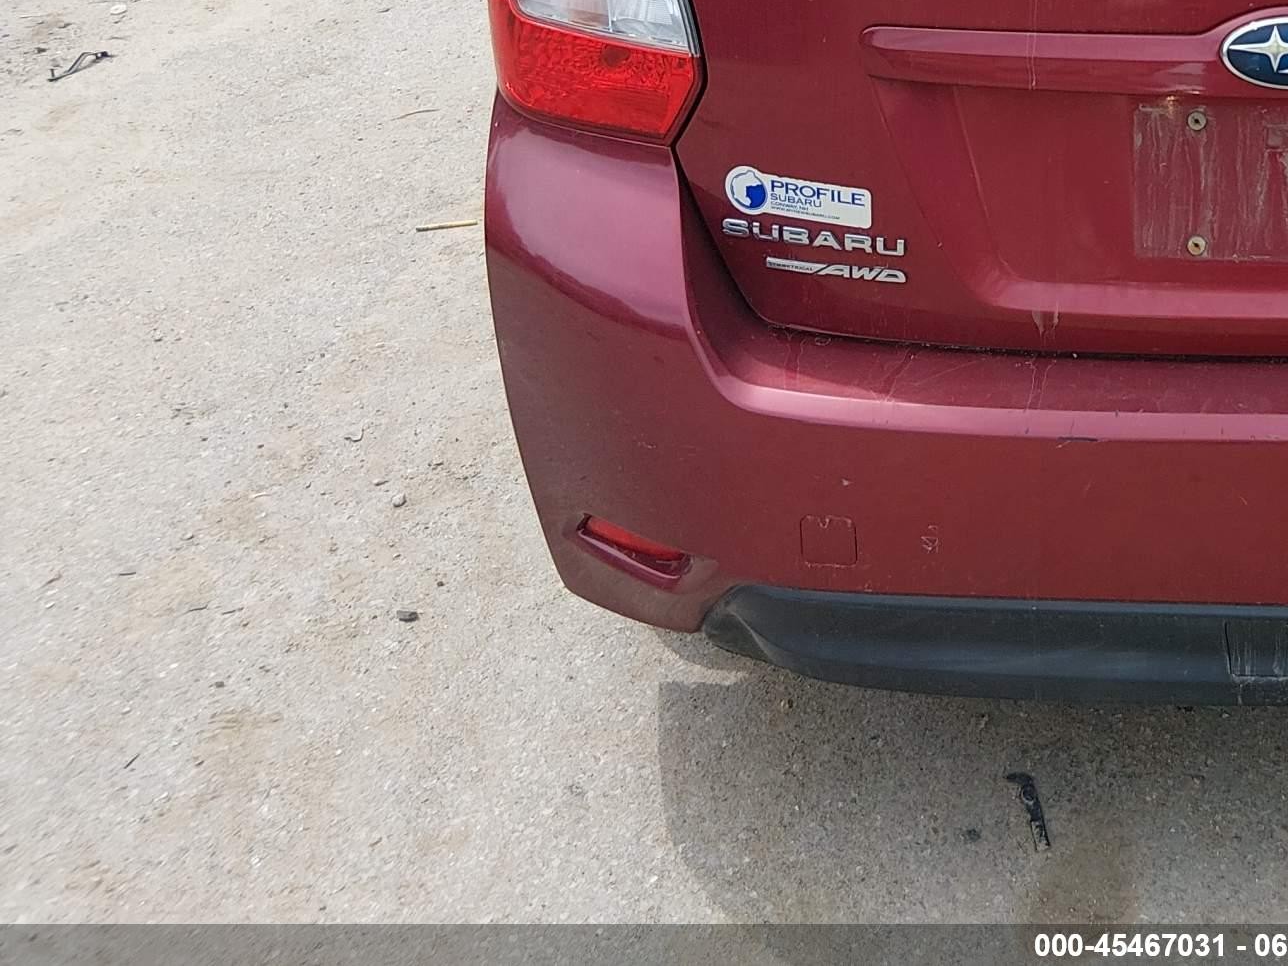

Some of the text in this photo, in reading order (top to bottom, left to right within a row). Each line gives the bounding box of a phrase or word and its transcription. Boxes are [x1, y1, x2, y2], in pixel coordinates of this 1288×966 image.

[770, 180, 866, 207] PROFILE
[770, 193, 822, 208] SUBARU
[722, 218, 905, 256] SUBARU
[815, 264, 907, 283] AWD
